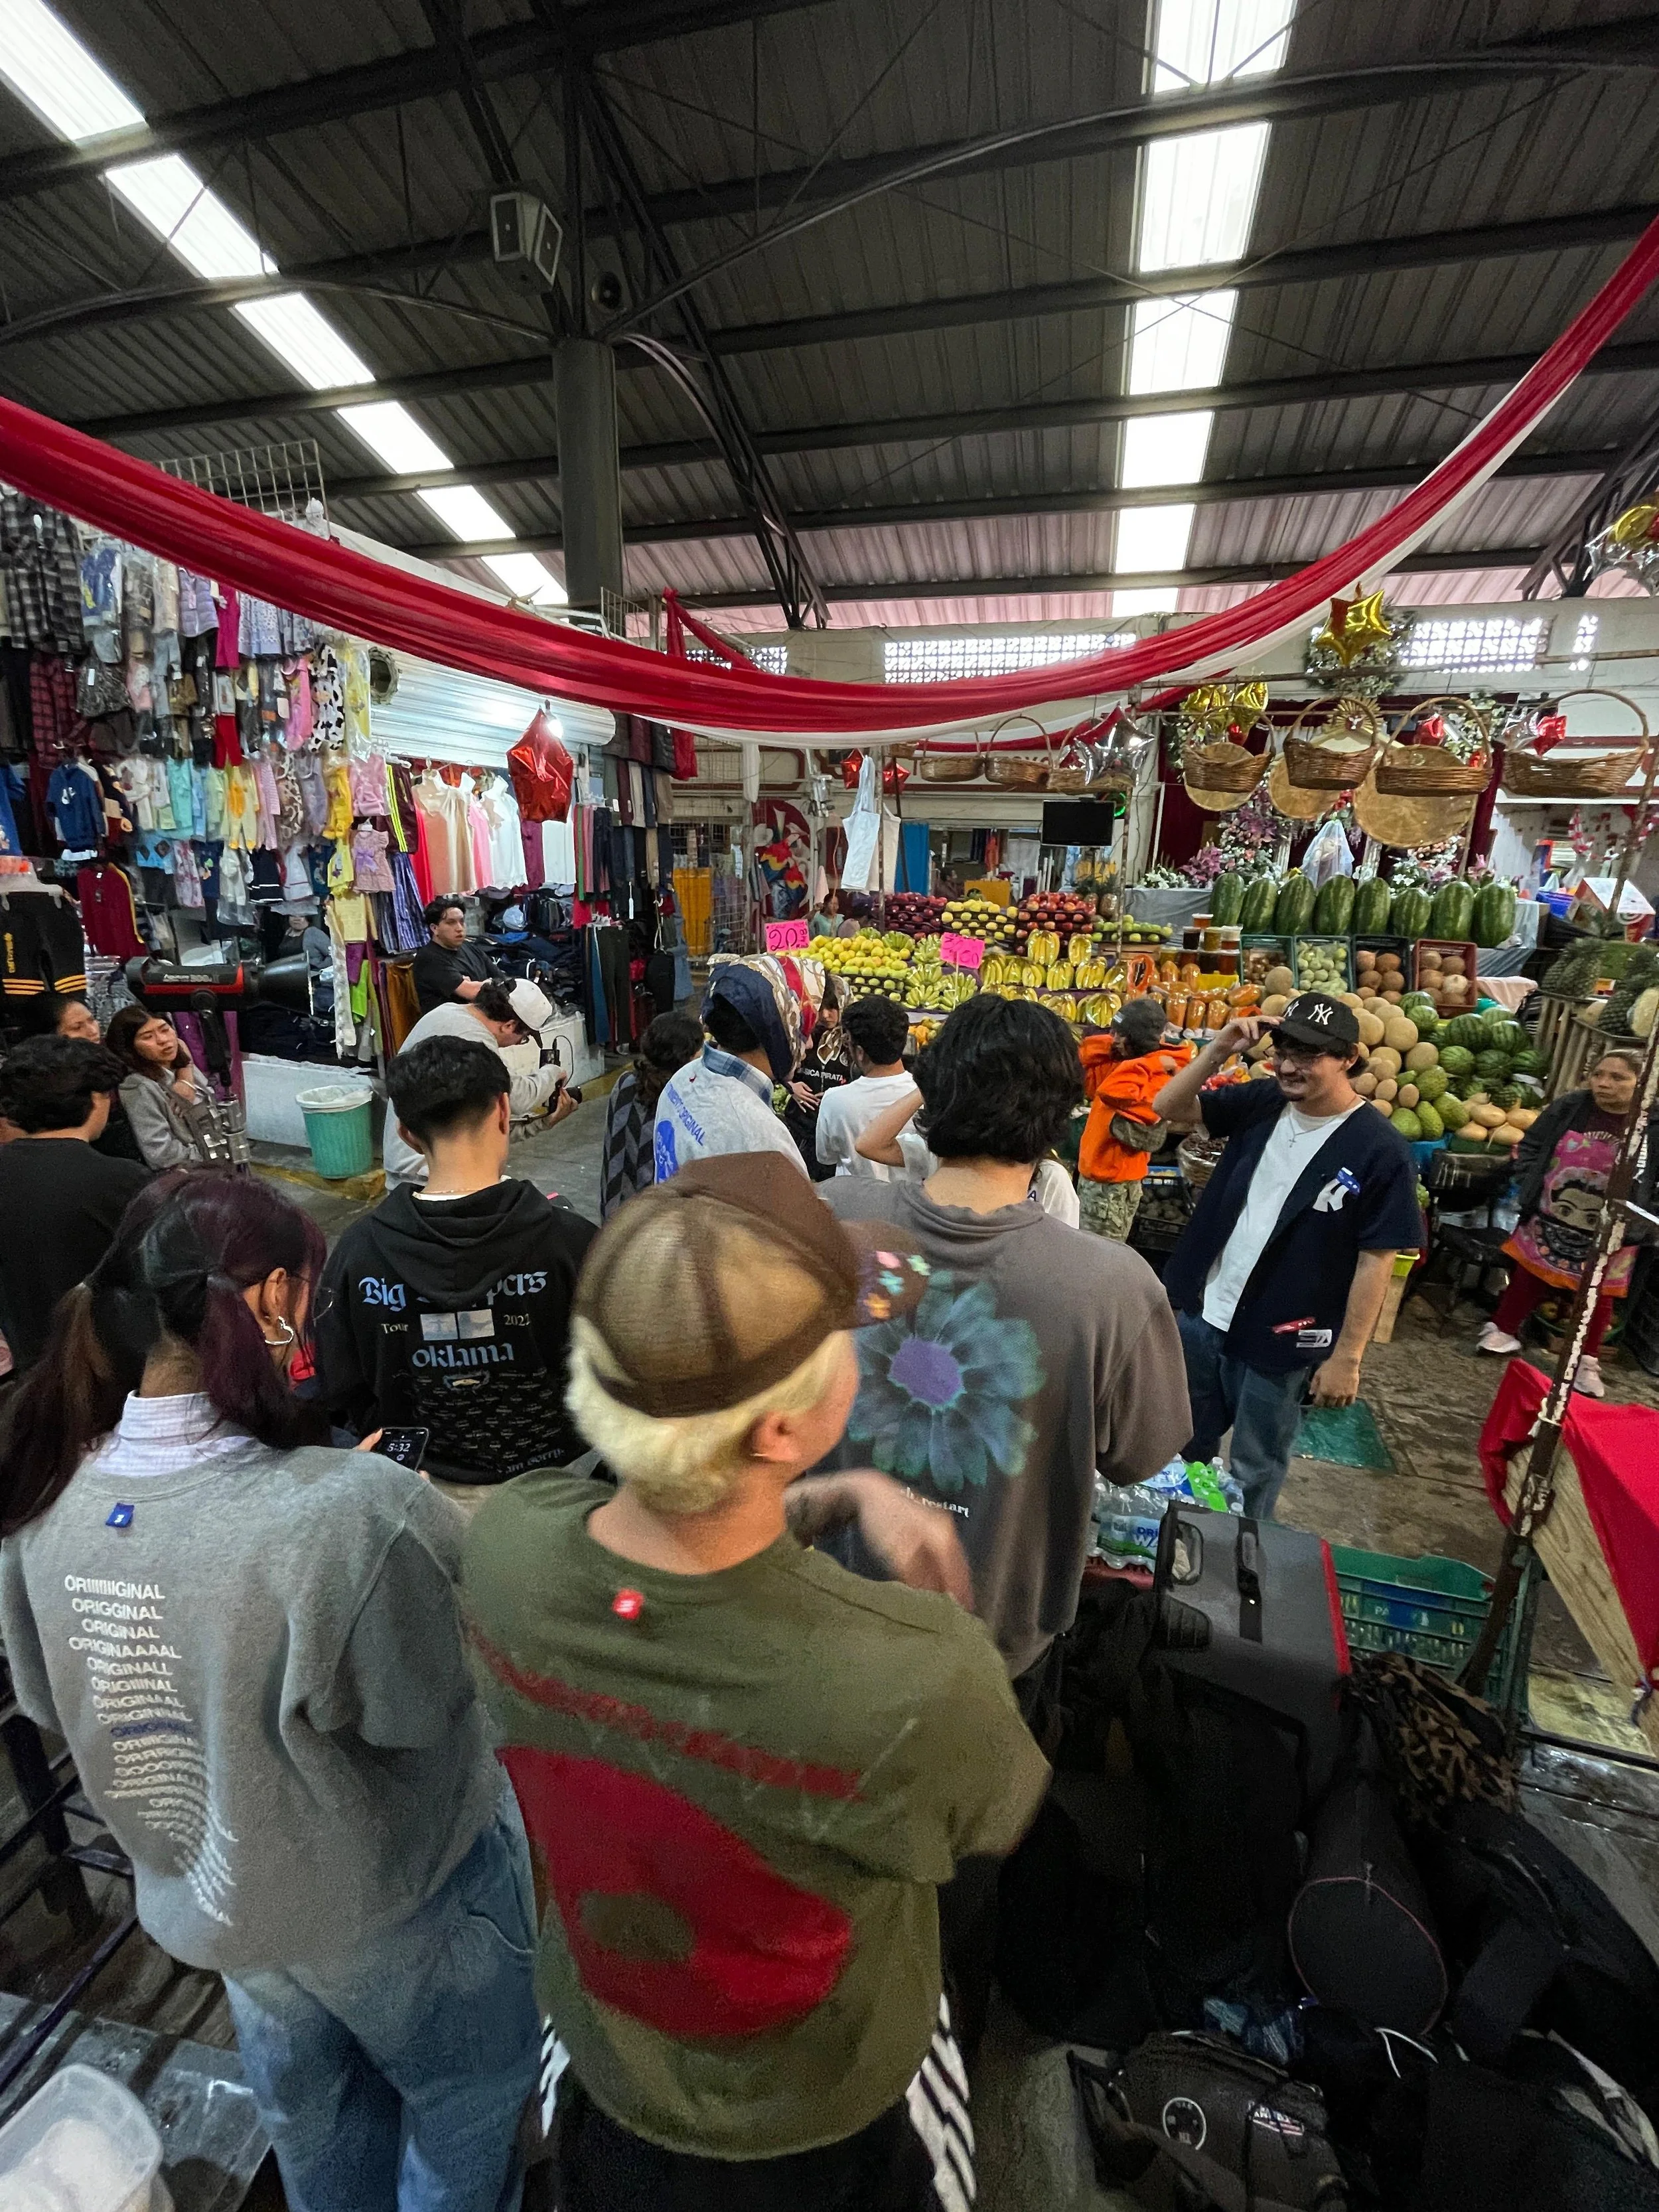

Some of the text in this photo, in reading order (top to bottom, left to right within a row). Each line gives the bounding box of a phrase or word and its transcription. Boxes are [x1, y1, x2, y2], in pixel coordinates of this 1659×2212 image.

[768, 928, 798, 951] 20
[1307, 1003, 1334, 1025] NY
[358, 1276, 407, 1312] Big
[380, 1323, 409, 1334] Tour
[387, 1443, 411, 1452] 5:32
[72, 1598, 163, 1620] ORIGGINAL
[82, 1618, 160, 1639] ORIGINAL
